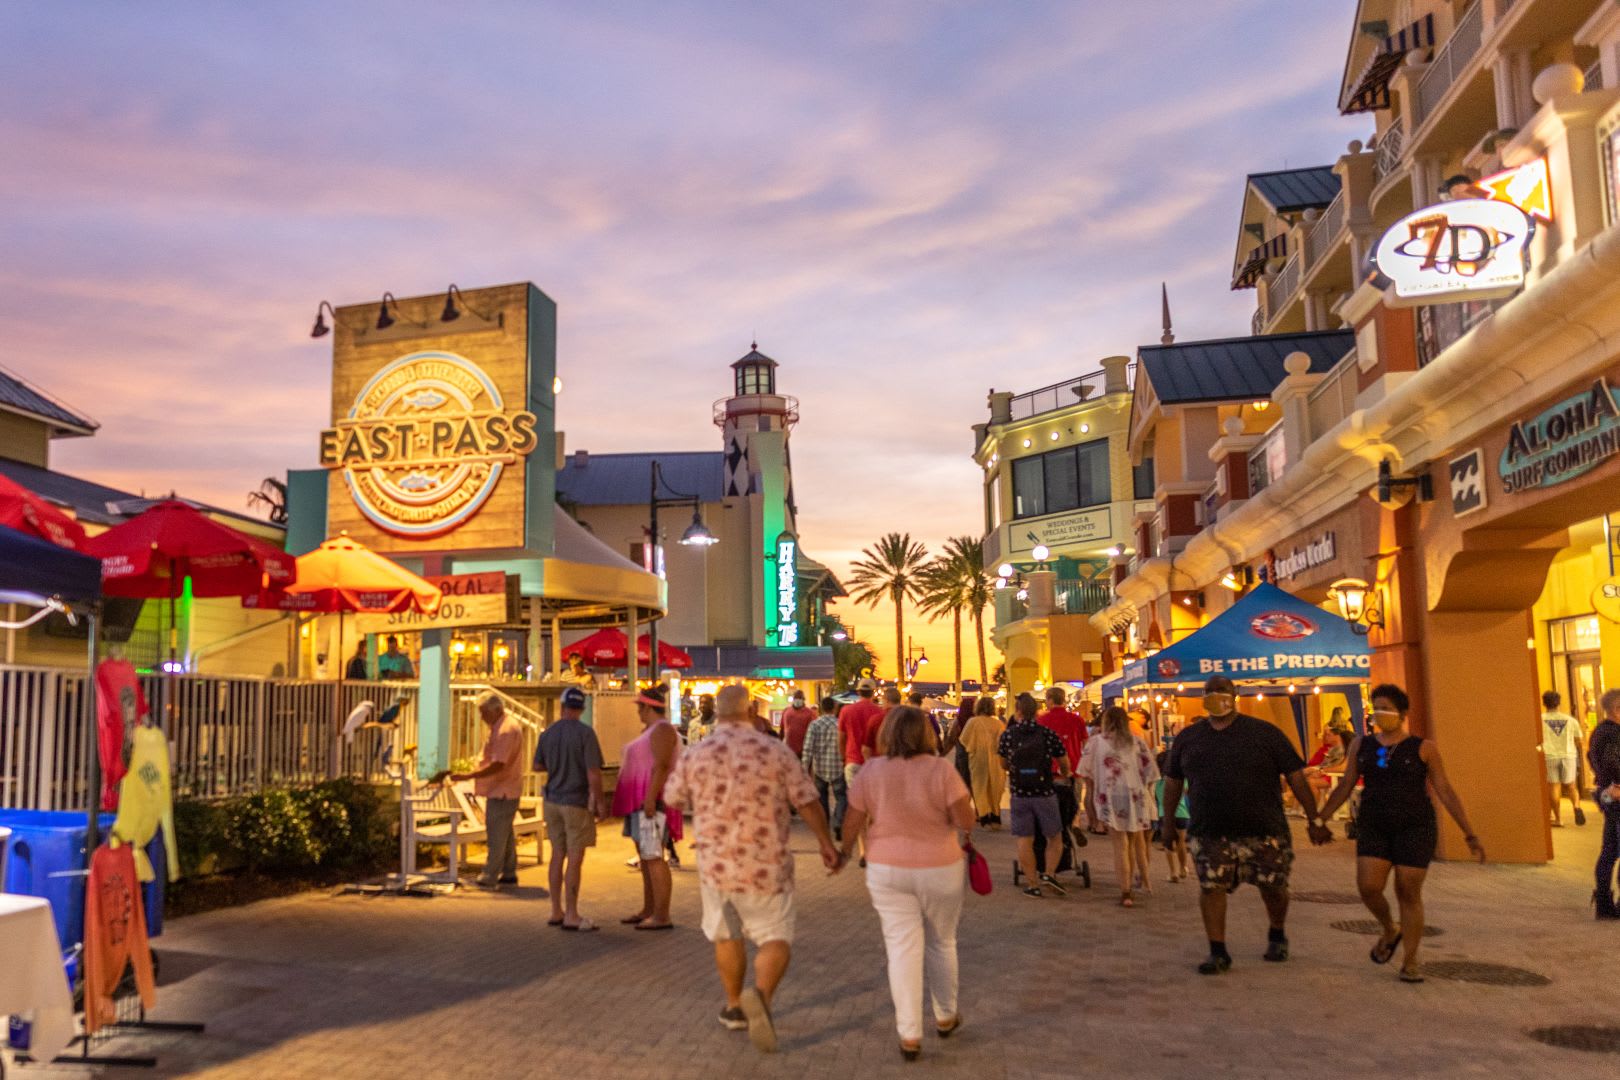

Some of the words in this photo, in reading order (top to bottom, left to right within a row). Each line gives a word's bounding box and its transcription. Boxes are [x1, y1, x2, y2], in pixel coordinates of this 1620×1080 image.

[1408, 213, 1492, 272] 7D
[1507, 376, 1620, 464] ALOHA
[320, 424, 414, 465] EAST
[432, 414, 537, 457] PASS
[1503, 460, 1543, 494] SURF
[1068, 523, 1096, 533] EVENTS
[101, 556, 128, 567] NGRY
[440, 578, 493, 597] OCAL.
[1199, 658, 1224, 674] BE
[1227, 656, 1269, 672] THE
